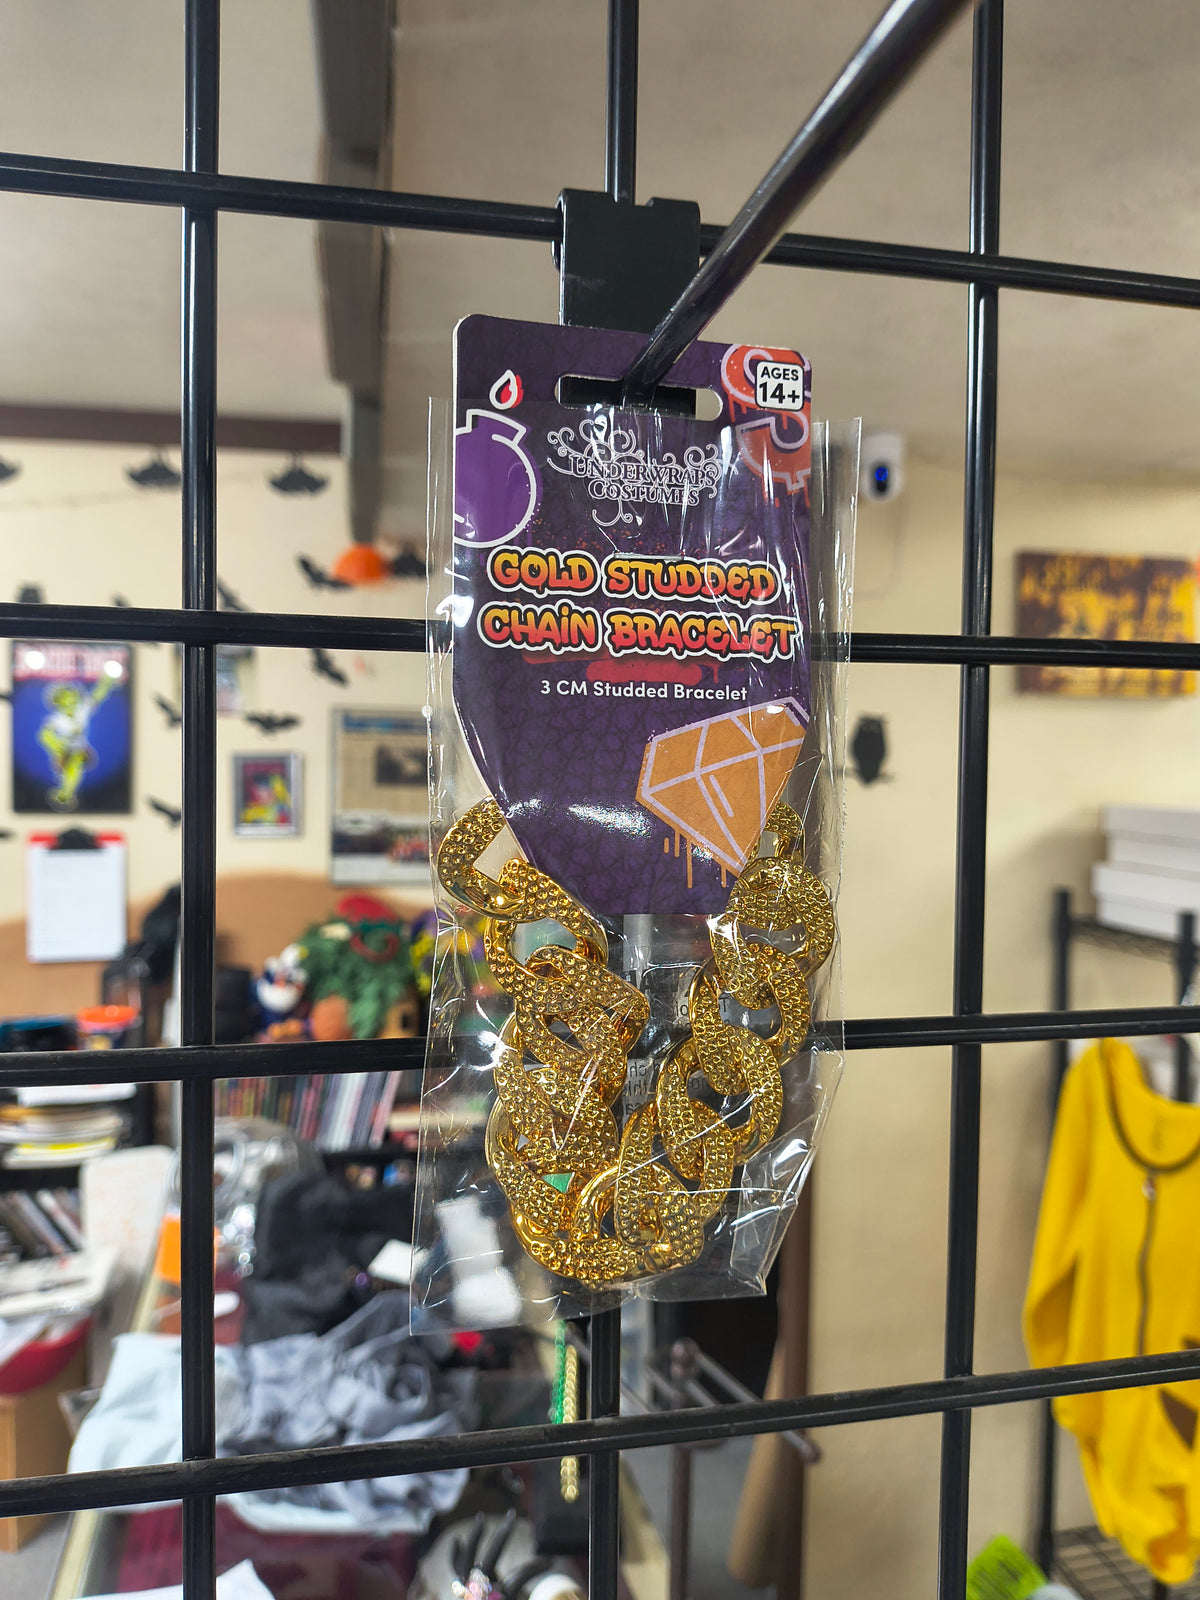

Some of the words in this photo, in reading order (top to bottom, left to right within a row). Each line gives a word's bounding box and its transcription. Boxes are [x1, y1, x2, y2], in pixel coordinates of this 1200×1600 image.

[760, 366, 799, 381] AGES
[759, 381, 800, 404] 14+
[569, 454, 717, 487] UNDERWRAPS
[588, 478, 700, 506] COSTUMES
[489, 546, 600, 597] GOLD
[602, 558, 781, 607] STUDDED
[605, 609, 802, 662] BRACELET
[540, 680, 551, 695] 3
[556, 680, 588, 696] CM
[593, 682, 668, 698] Studded
[673, 684, 748, 700] Bracelet
